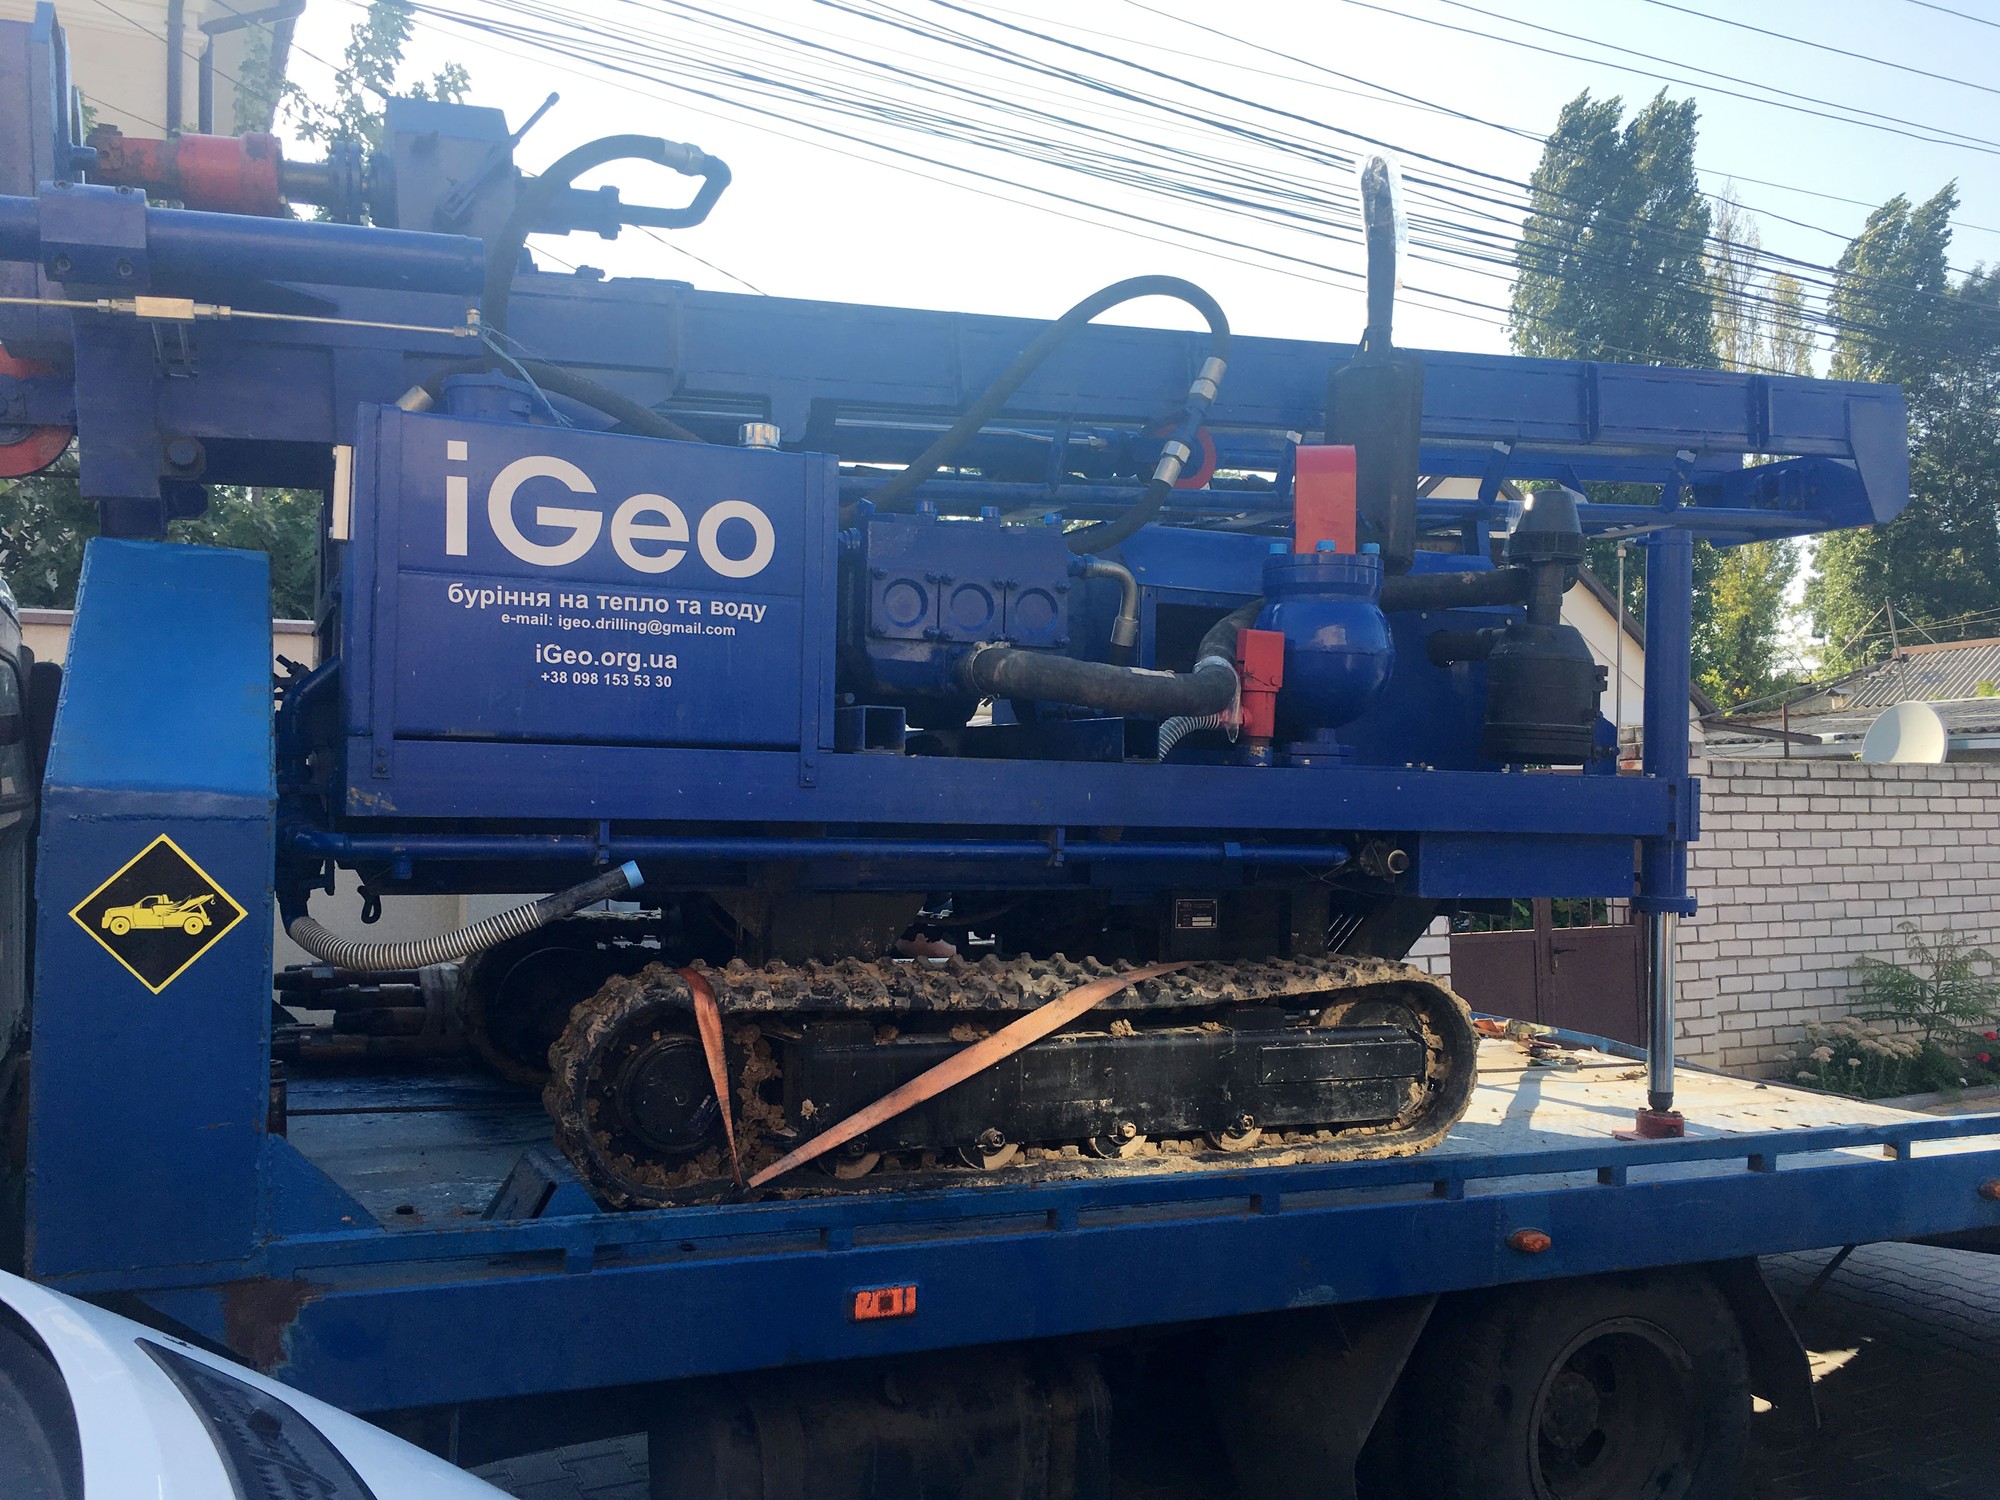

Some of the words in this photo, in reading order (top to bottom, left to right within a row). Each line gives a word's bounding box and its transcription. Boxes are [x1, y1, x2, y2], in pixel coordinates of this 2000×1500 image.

[446, 440, 775, 578] iGeo
[447, 583, 551, 610] буріння
[559, 588, 589, 609] на
[596, 595, 670, 614] тепло
[676, 600, 702, 615] та
[710, 601, 768, 624] воду
[501, 612, 554, 627] e-mail:
[557, 616, 737, 637] igeo.drilling@gmail.com
[535, 643, 678, 672] iGeo.org.ua
[540, 671, 568, 685] +38
[572, 671, 599, 685] 098
[603, 673, 629, 686] 153
[633, 674, 651, 687] 53
[655, 675, 673, 688] 30
